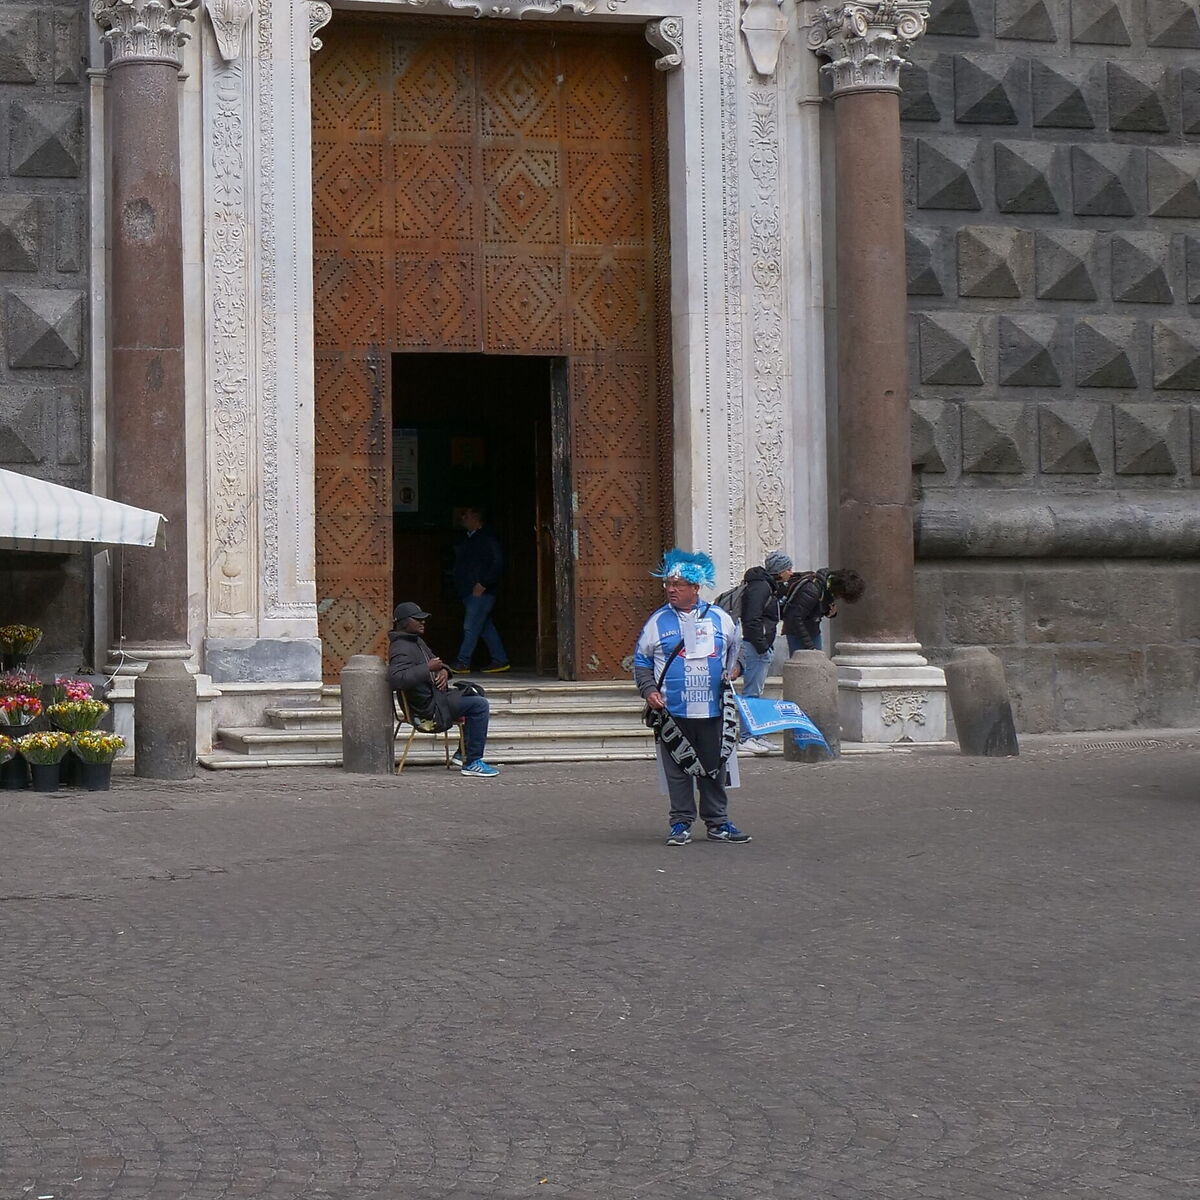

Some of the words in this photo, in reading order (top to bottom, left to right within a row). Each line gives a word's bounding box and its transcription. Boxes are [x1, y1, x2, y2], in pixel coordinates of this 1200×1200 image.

[661, 629, 680, 638] NAPOLI
[684, 675, 711, 688] JUVE
[681, 690, 714, 703] MERDA
